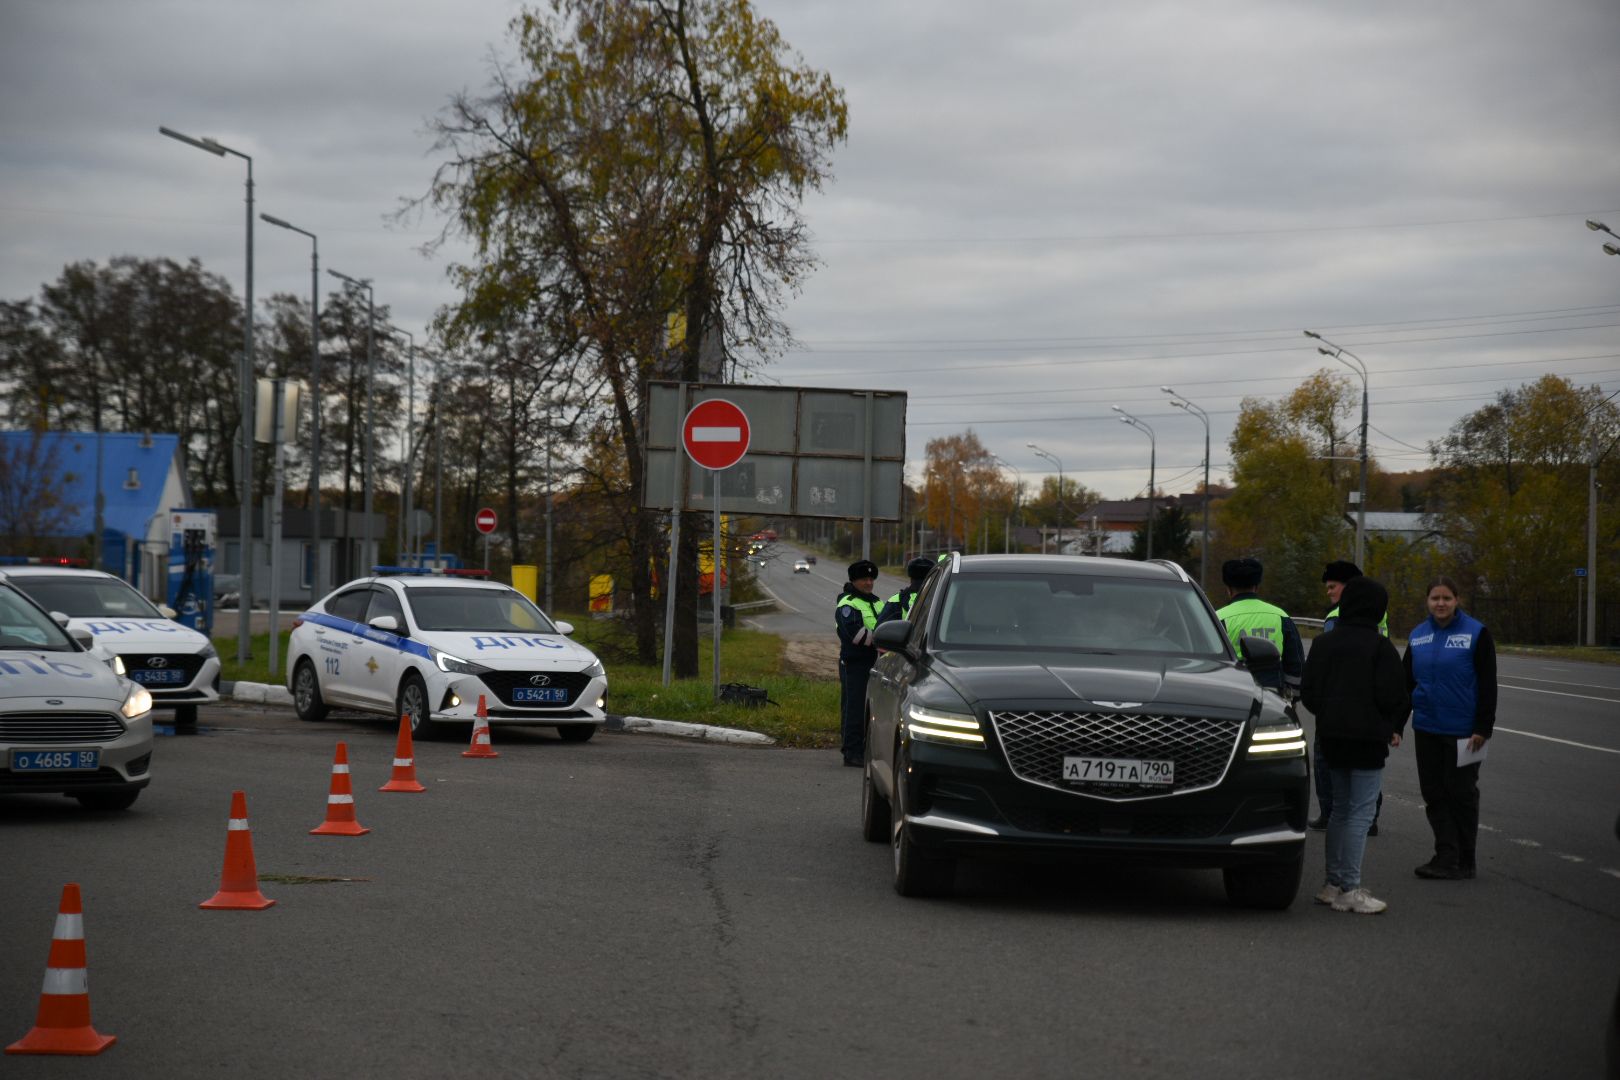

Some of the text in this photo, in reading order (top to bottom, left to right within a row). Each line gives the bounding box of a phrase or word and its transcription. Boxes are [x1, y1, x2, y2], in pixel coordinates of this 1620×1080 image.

[85, 622, 176, 635] ДПС
[470, 636, 564, 650] ДПС
[0, 658, 93, 679] ПС
[325, 656, 340, 676] 112
[527, 689, 550, 700] 5421
[555, 689, 564, 698] 50
[35, 752, 73, 768] 4685
[79, 751, 94, 763] 50
[1069, 759, 1139, 780] А719ТА
[1143, 761, 1169, 776] 790
